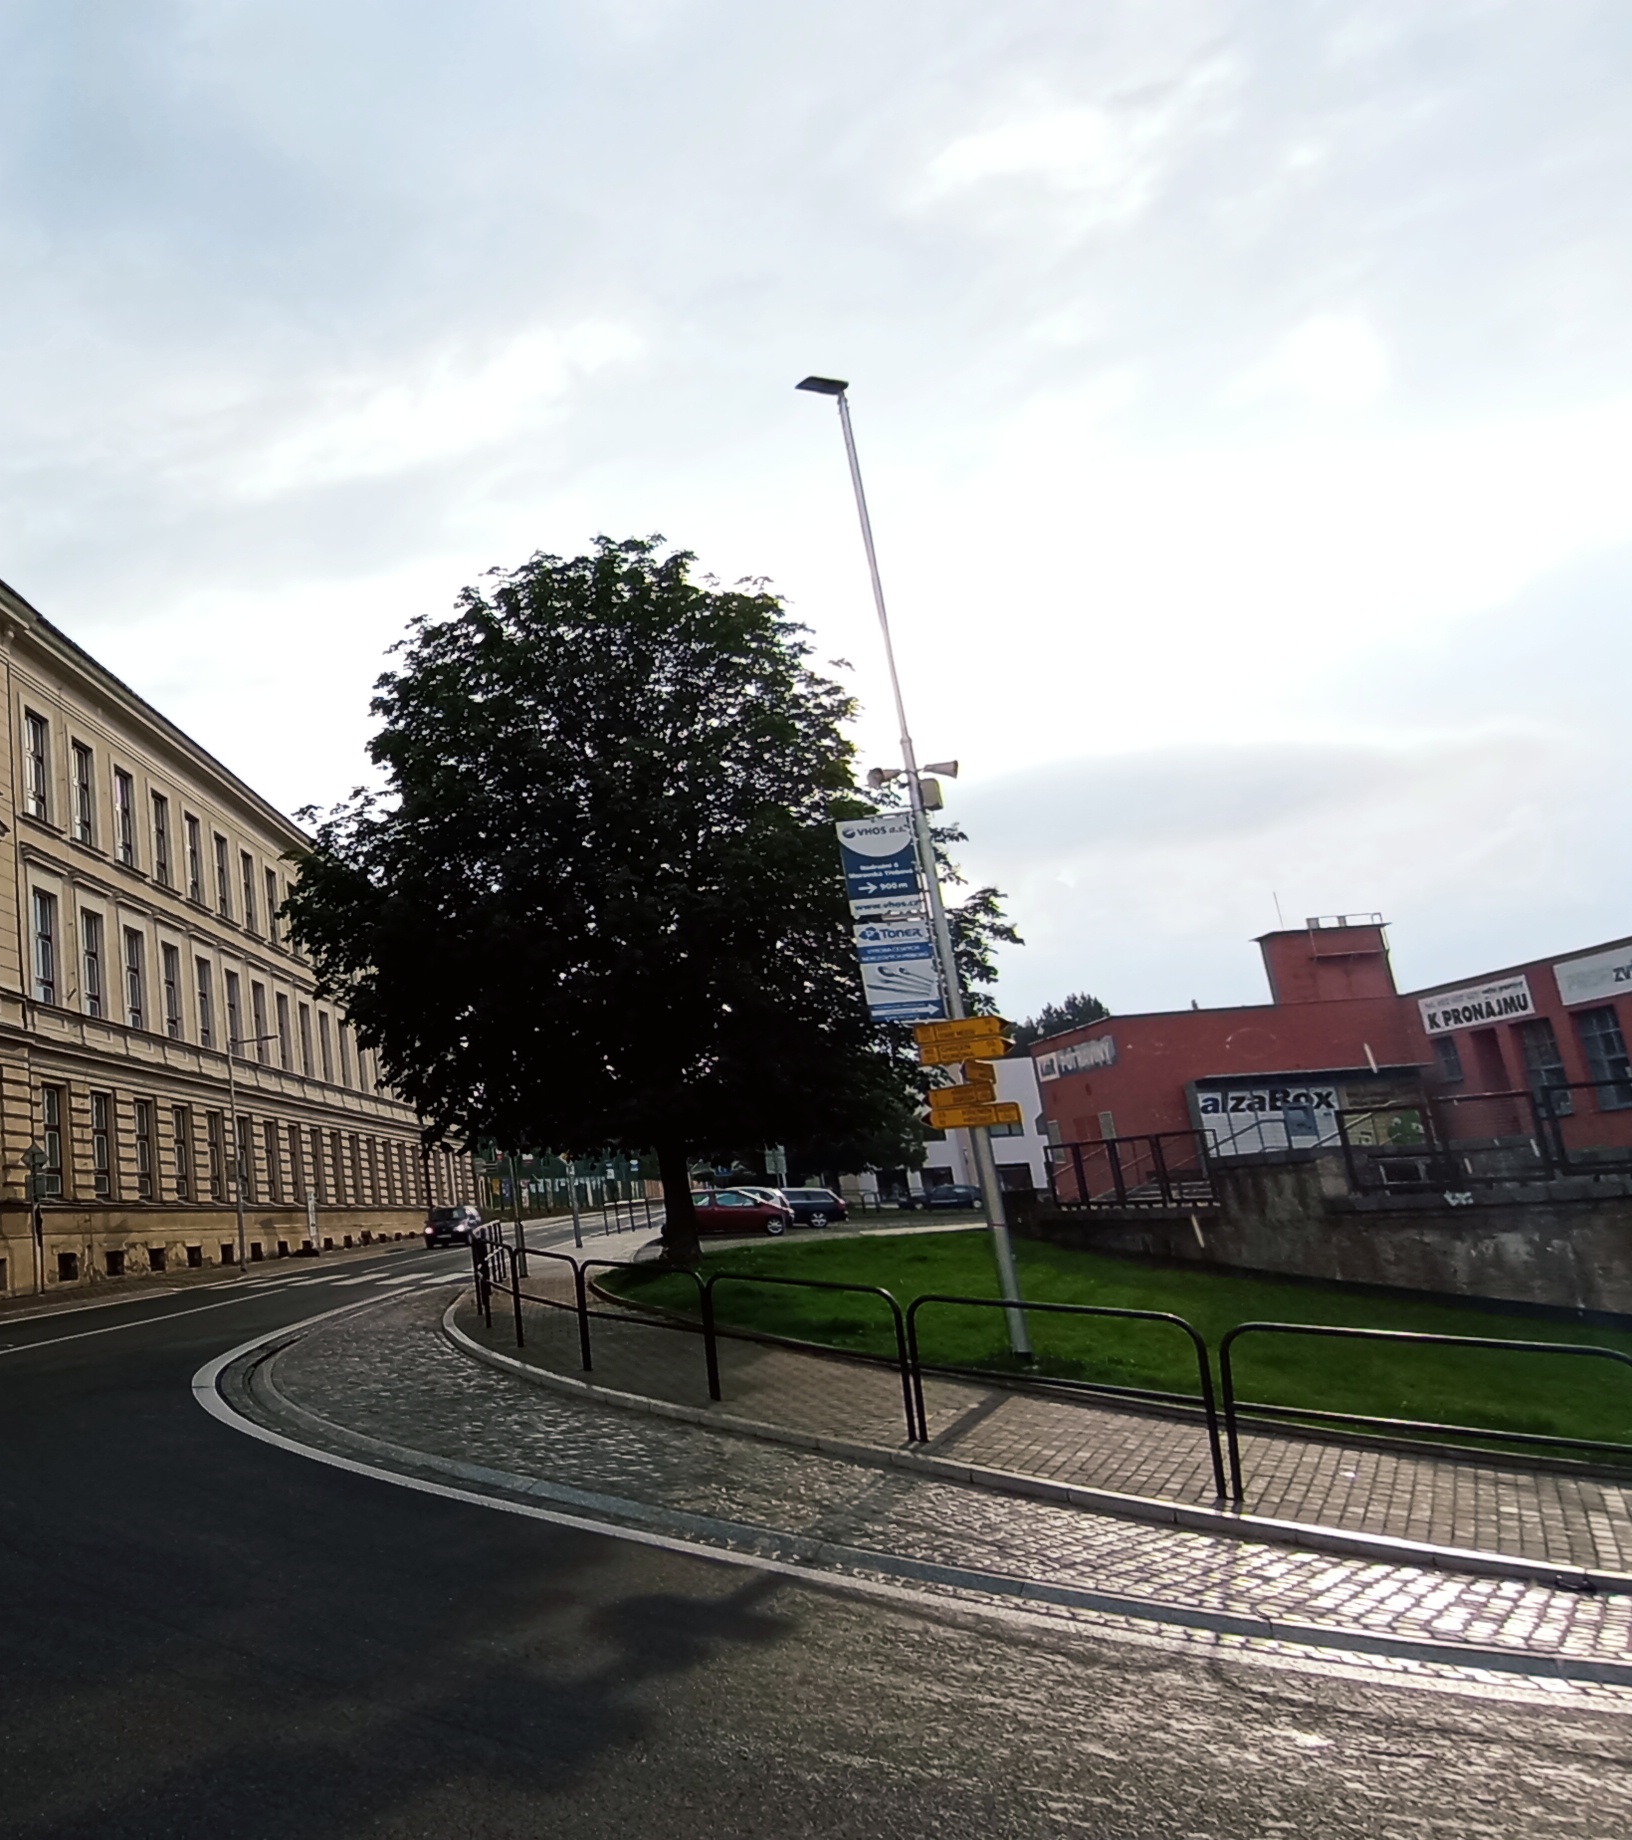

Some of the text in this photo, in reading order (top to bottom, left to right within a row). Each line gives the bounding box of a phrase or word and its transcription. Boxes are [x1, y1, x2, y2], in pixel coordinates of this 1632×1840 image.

[857, 826, 887, 836] VHOS
[1427, 993, 1529, 1029] K PRONÁJMU
[1200, 1089, 1336, 1114] alzaBox
